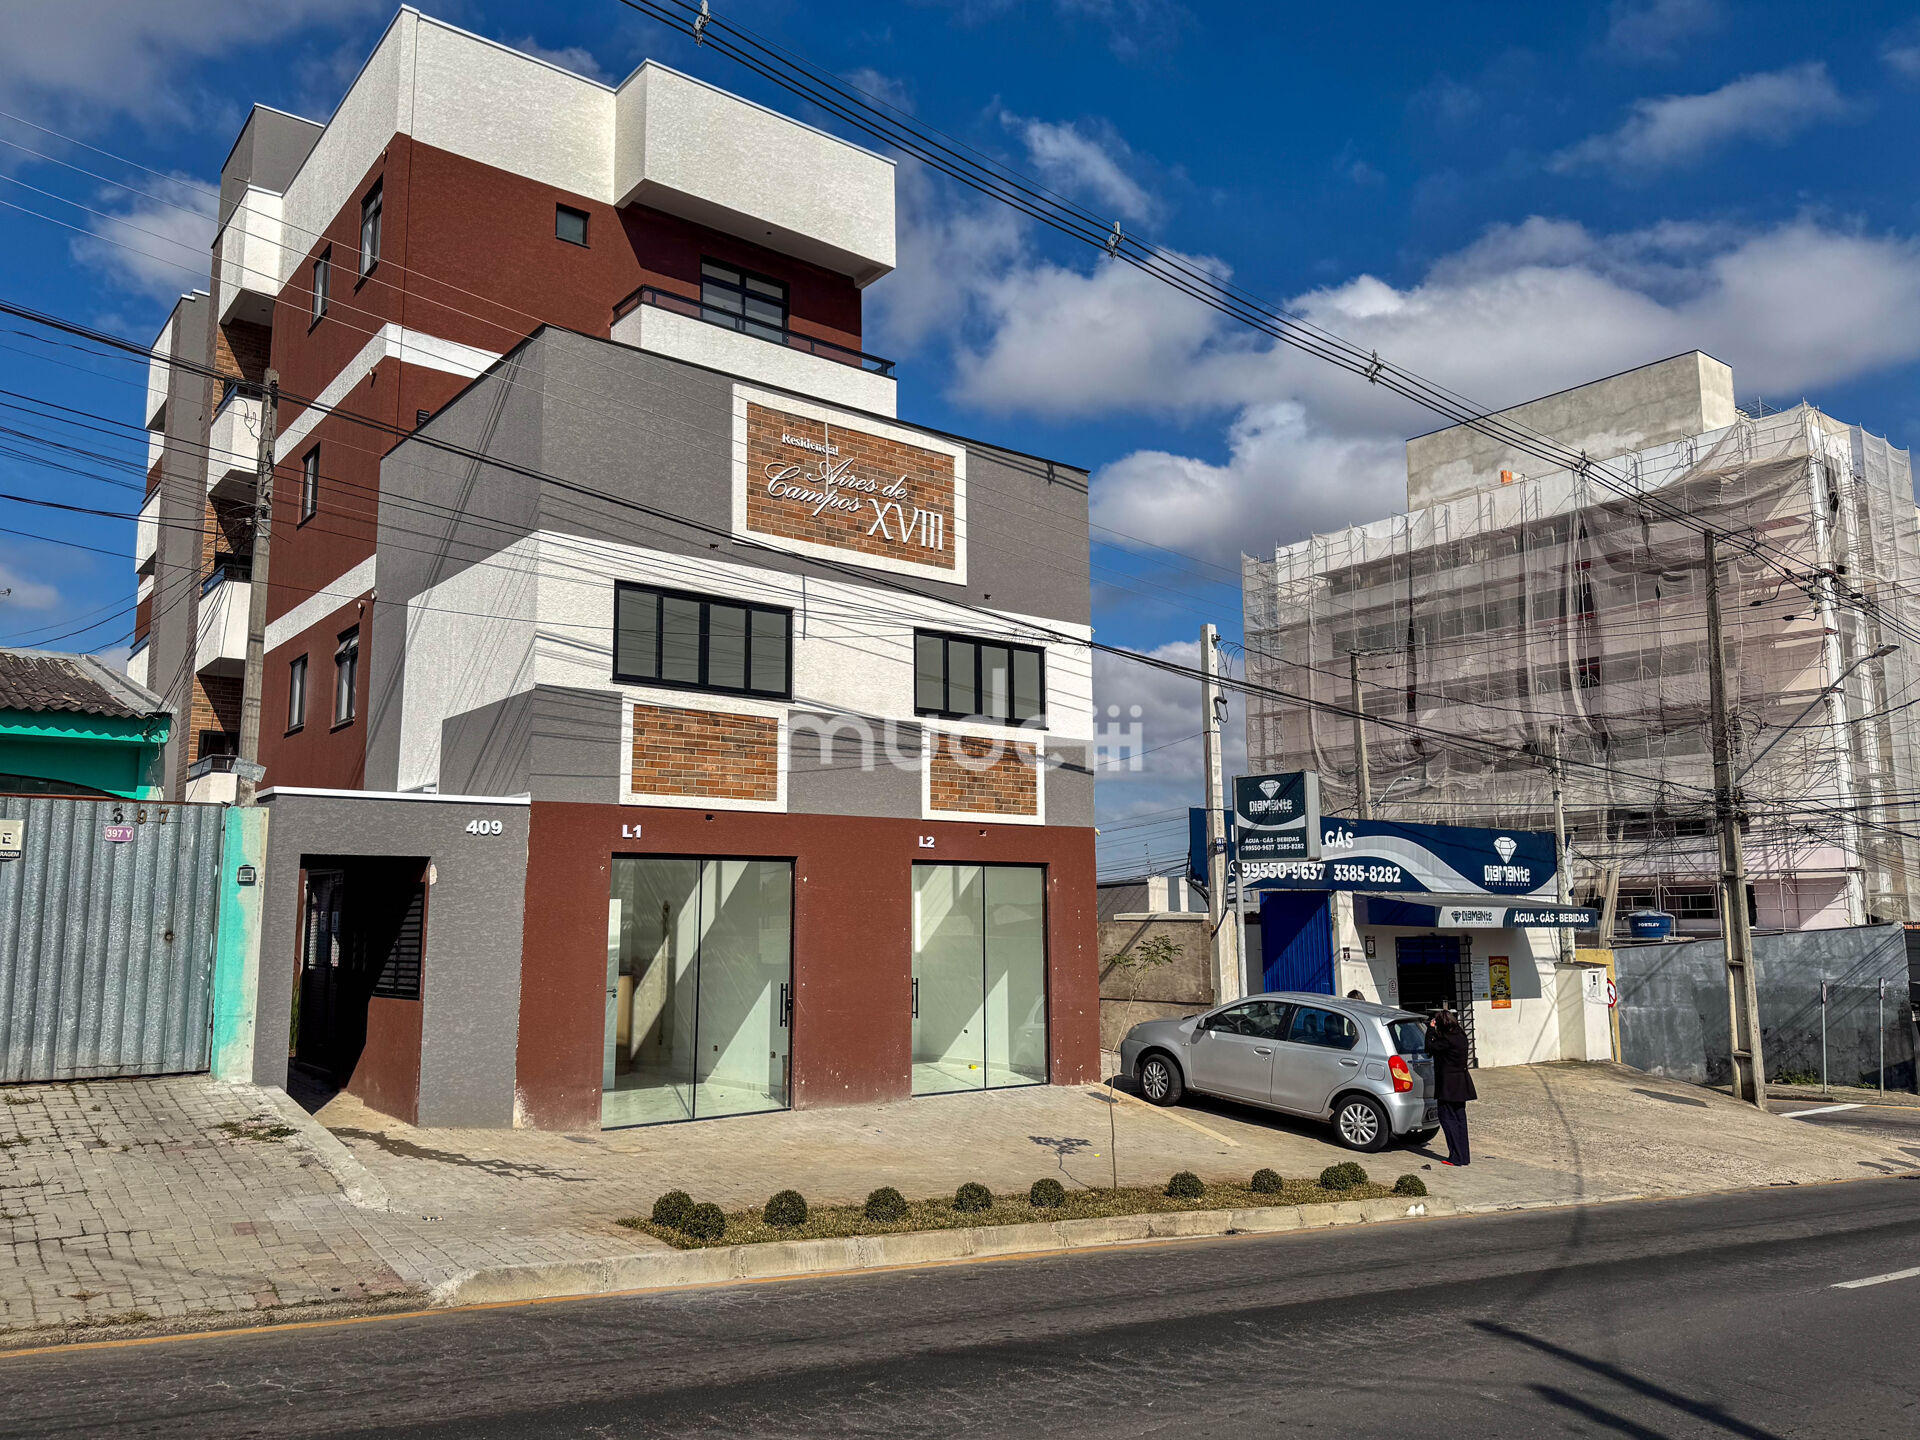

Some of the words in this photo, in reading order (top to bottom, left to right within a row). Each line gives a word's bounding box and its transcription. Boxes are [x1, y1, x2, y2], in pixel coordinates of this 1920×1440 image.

[782, 433, 839, 456] Residencial
[806, 458, 878, 493] Aires
[882, 475, 908, 500] de
[765, 462, 862, 517] Campos
[867, 498, 944, 551] XVIII
[106, 829, 124, 839] 397
[125, 829, 133, 838] Y
[465, 819, 503, 836] 409
[621, 824, 642, 840] L1
[918, 836, 935, 849] L2
[1262, 835, 1274, 843] GÁS
[1325, 827, 1354, 849] GÁS
[1242, 862, 1326, 881] 99550-9637
[1334, 864, 1401, 883] 3385-8282
[1514, 911, 1535, 923] ÁGUA
[1540, 911, 1555, 923] GÁS
[1559, 913, 1590, 923] BEBIDAS
